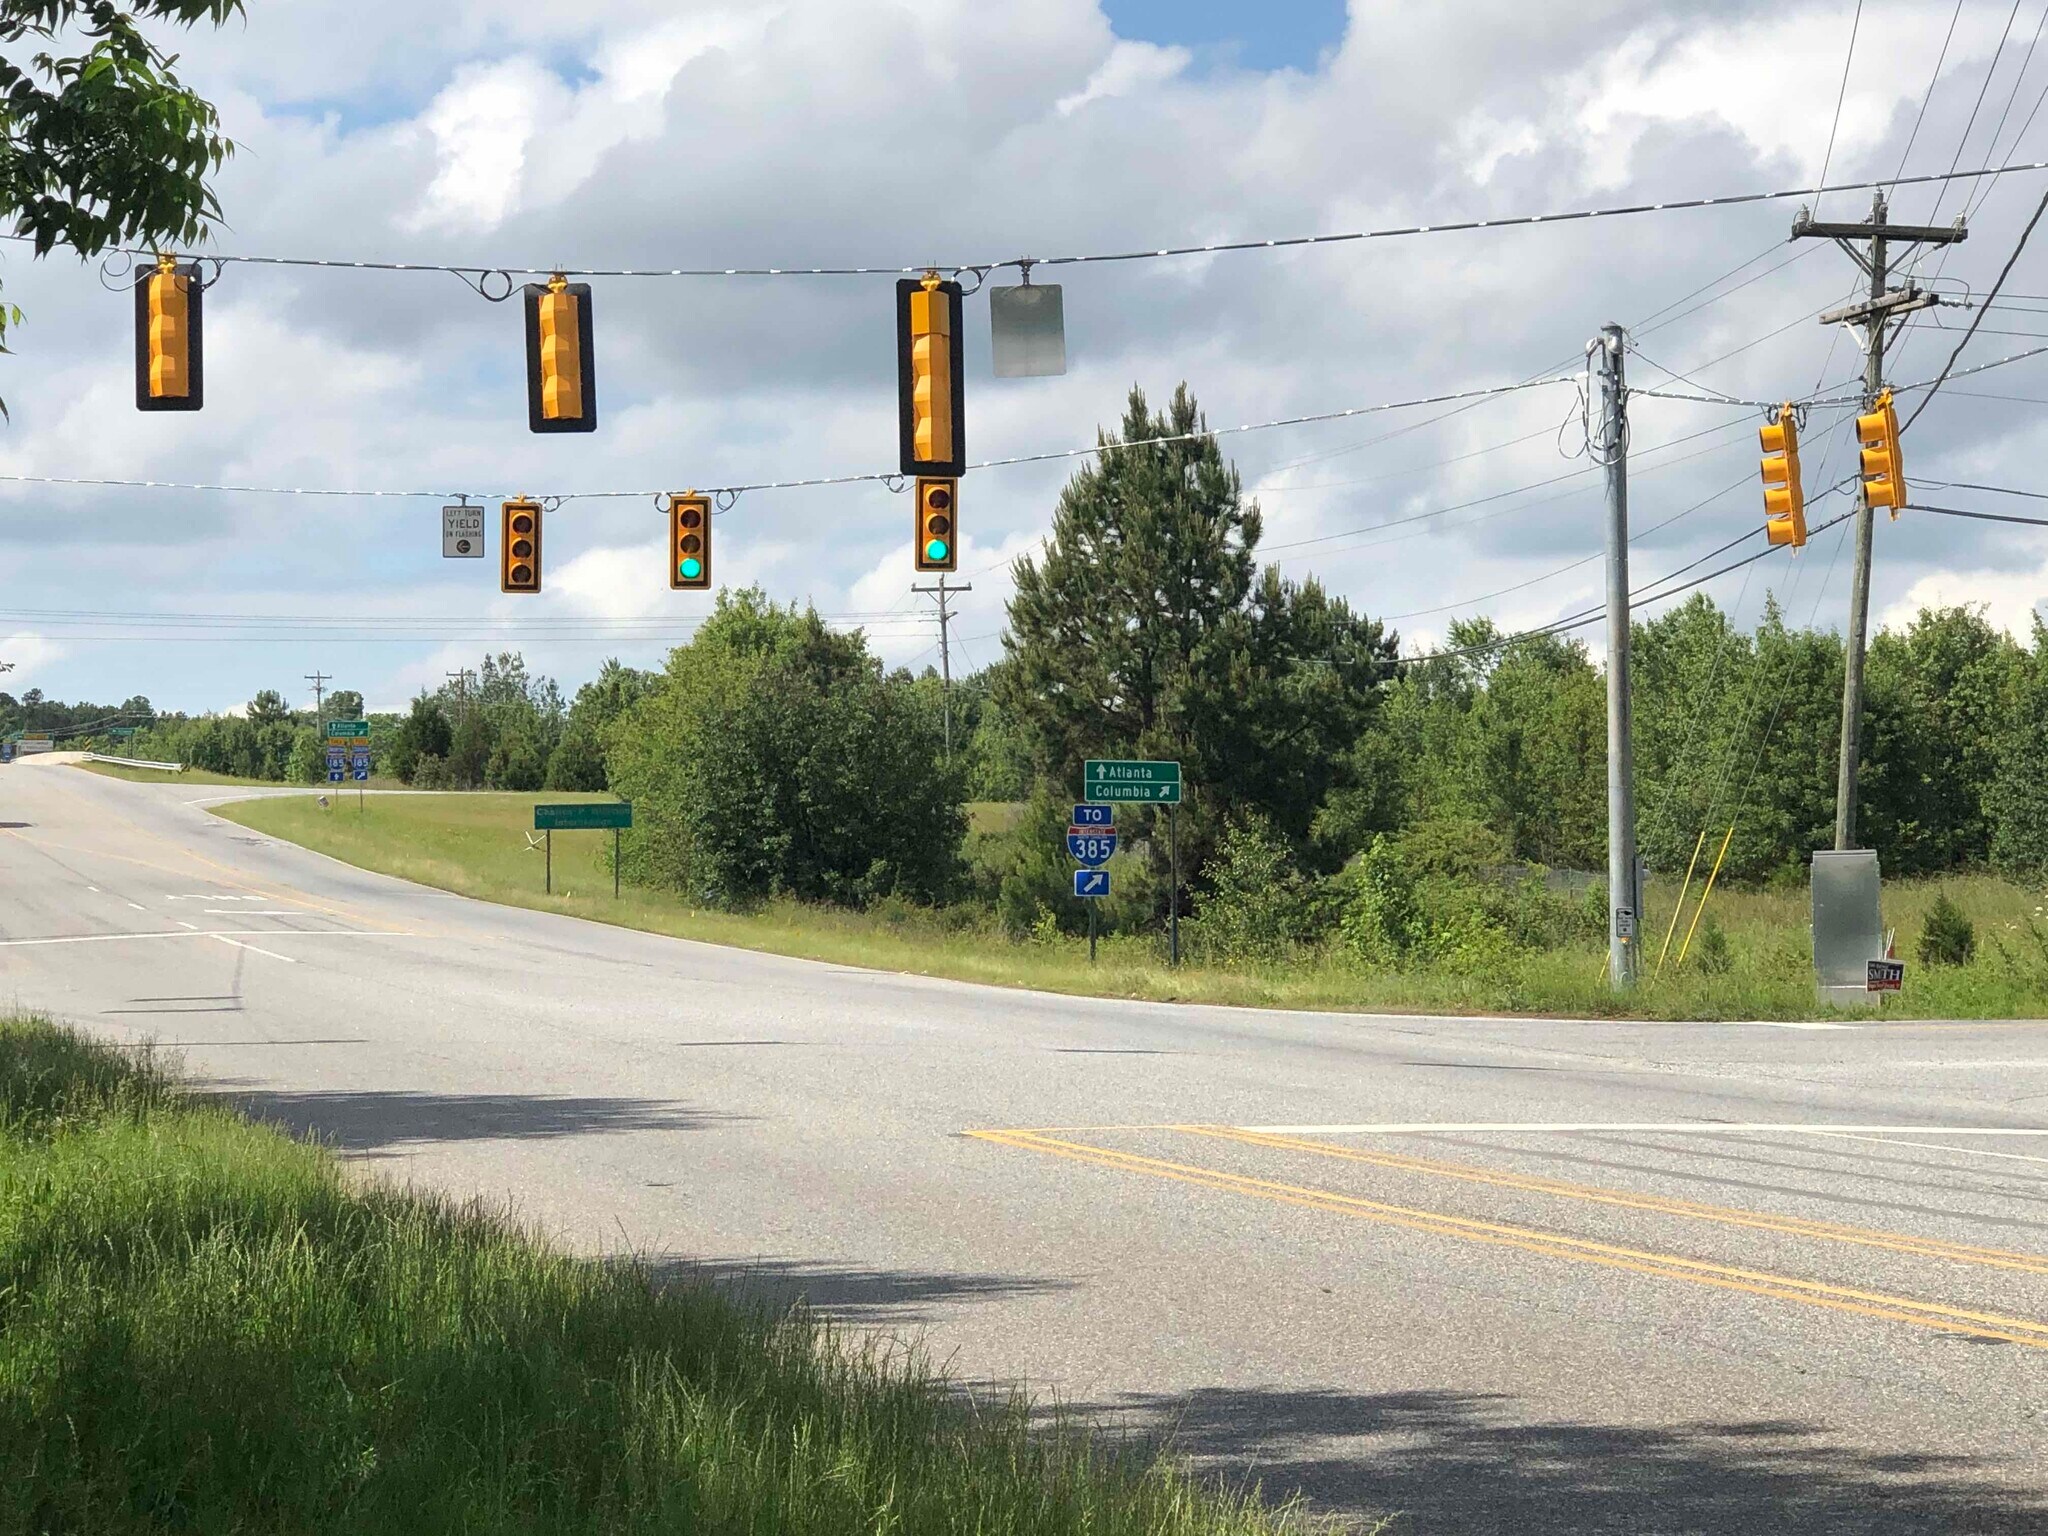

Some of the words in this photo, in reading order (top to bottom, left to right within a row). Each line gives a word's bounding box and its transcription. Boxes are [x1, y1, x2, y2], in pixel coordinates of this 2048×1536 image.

[447, 518, 480, 529] YIELD
[328, 759, 345, 768] 185
[353, 758, 369, 768] 185
[1109, 766, 1153, 779] Atlanta
[1095, 785, 1151, 798] Columbia
[1083, 809, 1102, 822] TO
[1076, 840, 1110, 859] 385
